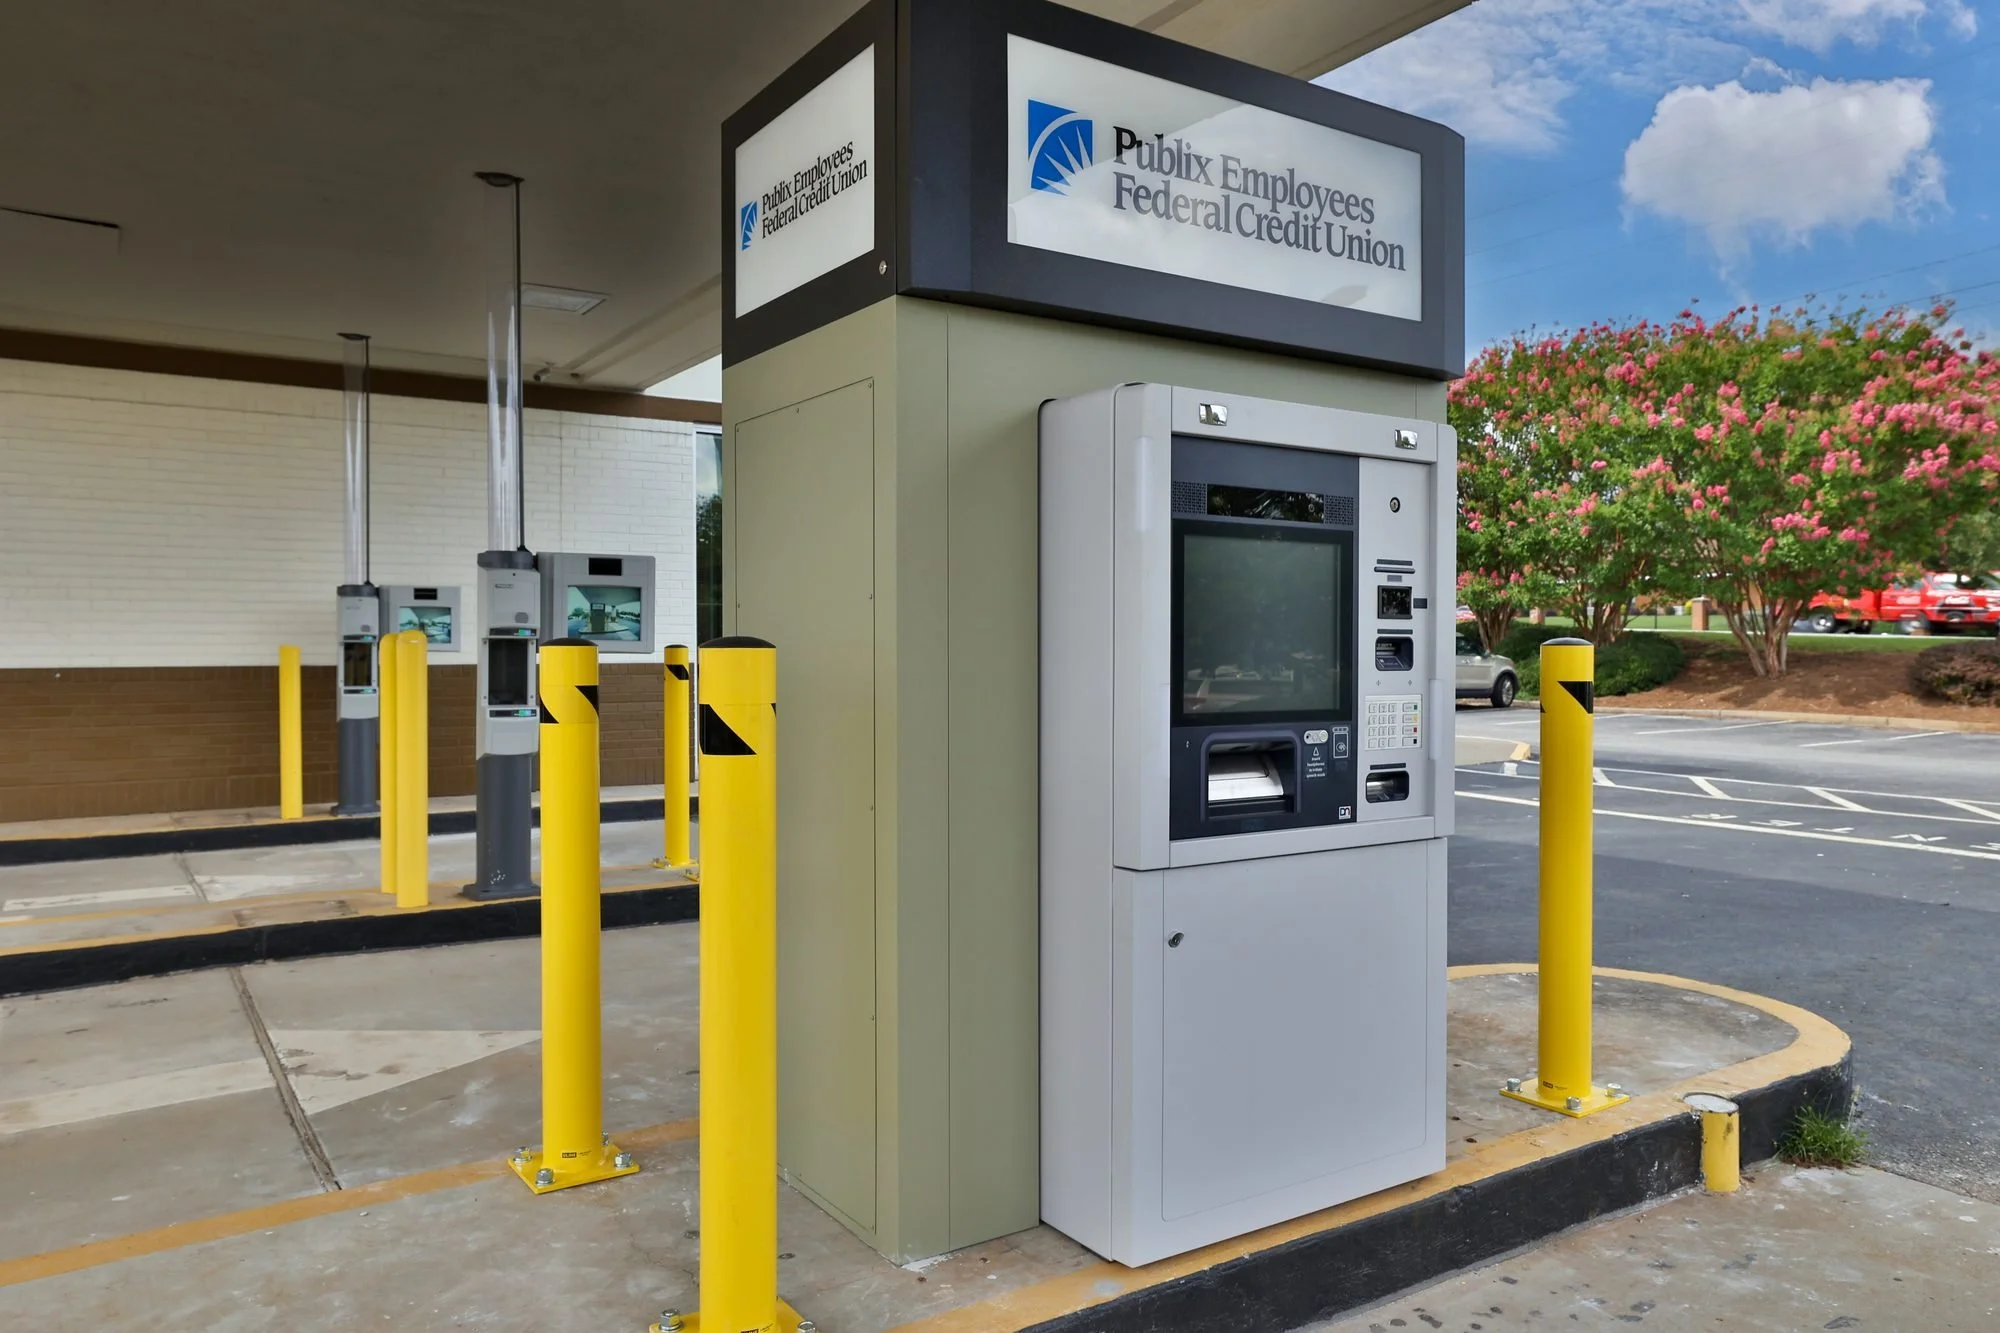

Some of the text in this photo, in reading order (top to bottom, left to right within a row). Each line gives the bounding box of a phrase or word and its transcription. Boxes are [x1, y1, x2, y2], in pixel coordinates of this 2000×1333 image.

[761, 140, 853, 216] Publix Employees
[761, 159, 867, 239] Federal Credit Union
[1112, 126, 1375, 224] Publix Employees
[1113, 172, 1406, 271] Federal Credit Union
